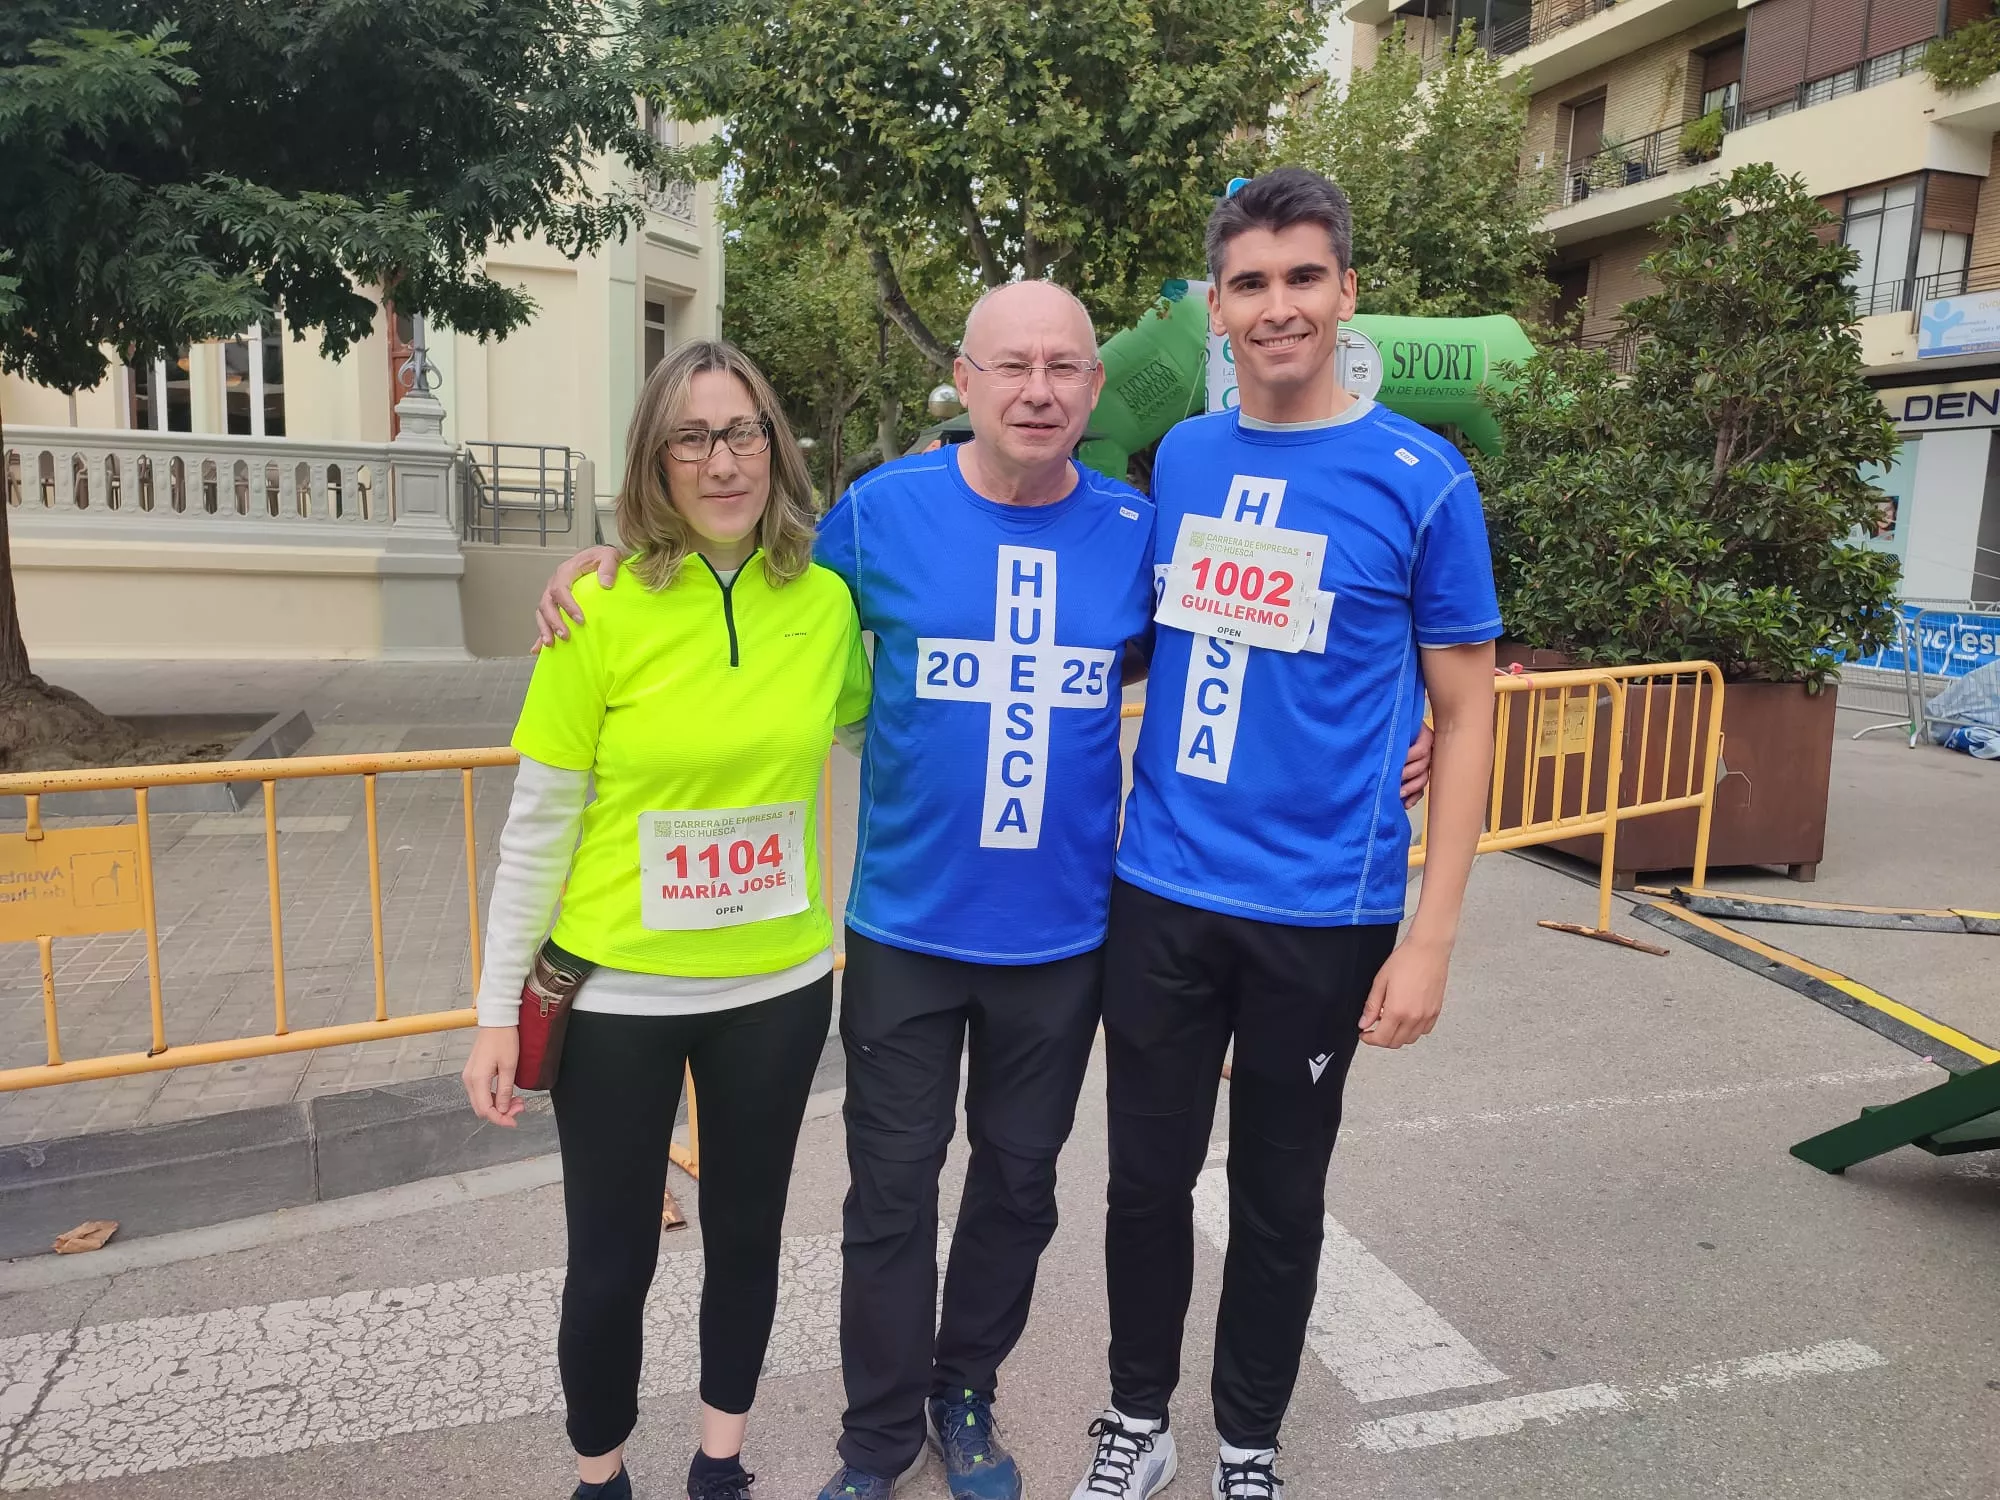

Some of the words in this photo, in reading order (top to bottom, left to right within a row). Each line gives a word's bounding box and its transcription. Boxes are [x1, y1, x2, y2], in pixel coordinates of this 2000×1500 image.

[1391, 341, 1478, 381] SPORT
[1398, 386, 1414, 395] DE
[1414, 386, 1466, 396] EVENTOS
[1204, 543, 1223, 553] ESIC
[1224, 546, 1254, 558] HUESCA
[1206, 533, 1245, 547] CARRERA
[1255, 542, 1299, 556] EMPRESAS
[1191, 556, 1294, 608] 1002
[1181, 594, 1289, 629] GUILLERMO
[1217, 626, 1242, 638] OPEN
[926, 651, 979, 688] 20
[1061, 659, 1104, 696] 25
[995, 559, 1043, 833] HUESCA
[674, 819, 720, 829] CARRERA
[722, 818, 734, 827] DE
[736, 811, 783, 825] EMPRESAS
[674, 829, 695, 838] ESIC
[698, 827, 736, 838] HUESCA
[665, 833, 783, 879] 1104
[662, 880, 732, 899] MARÍA
[738, 870, 787, 895] JOSÉ
[715, 905, 744, 916] OPEN
